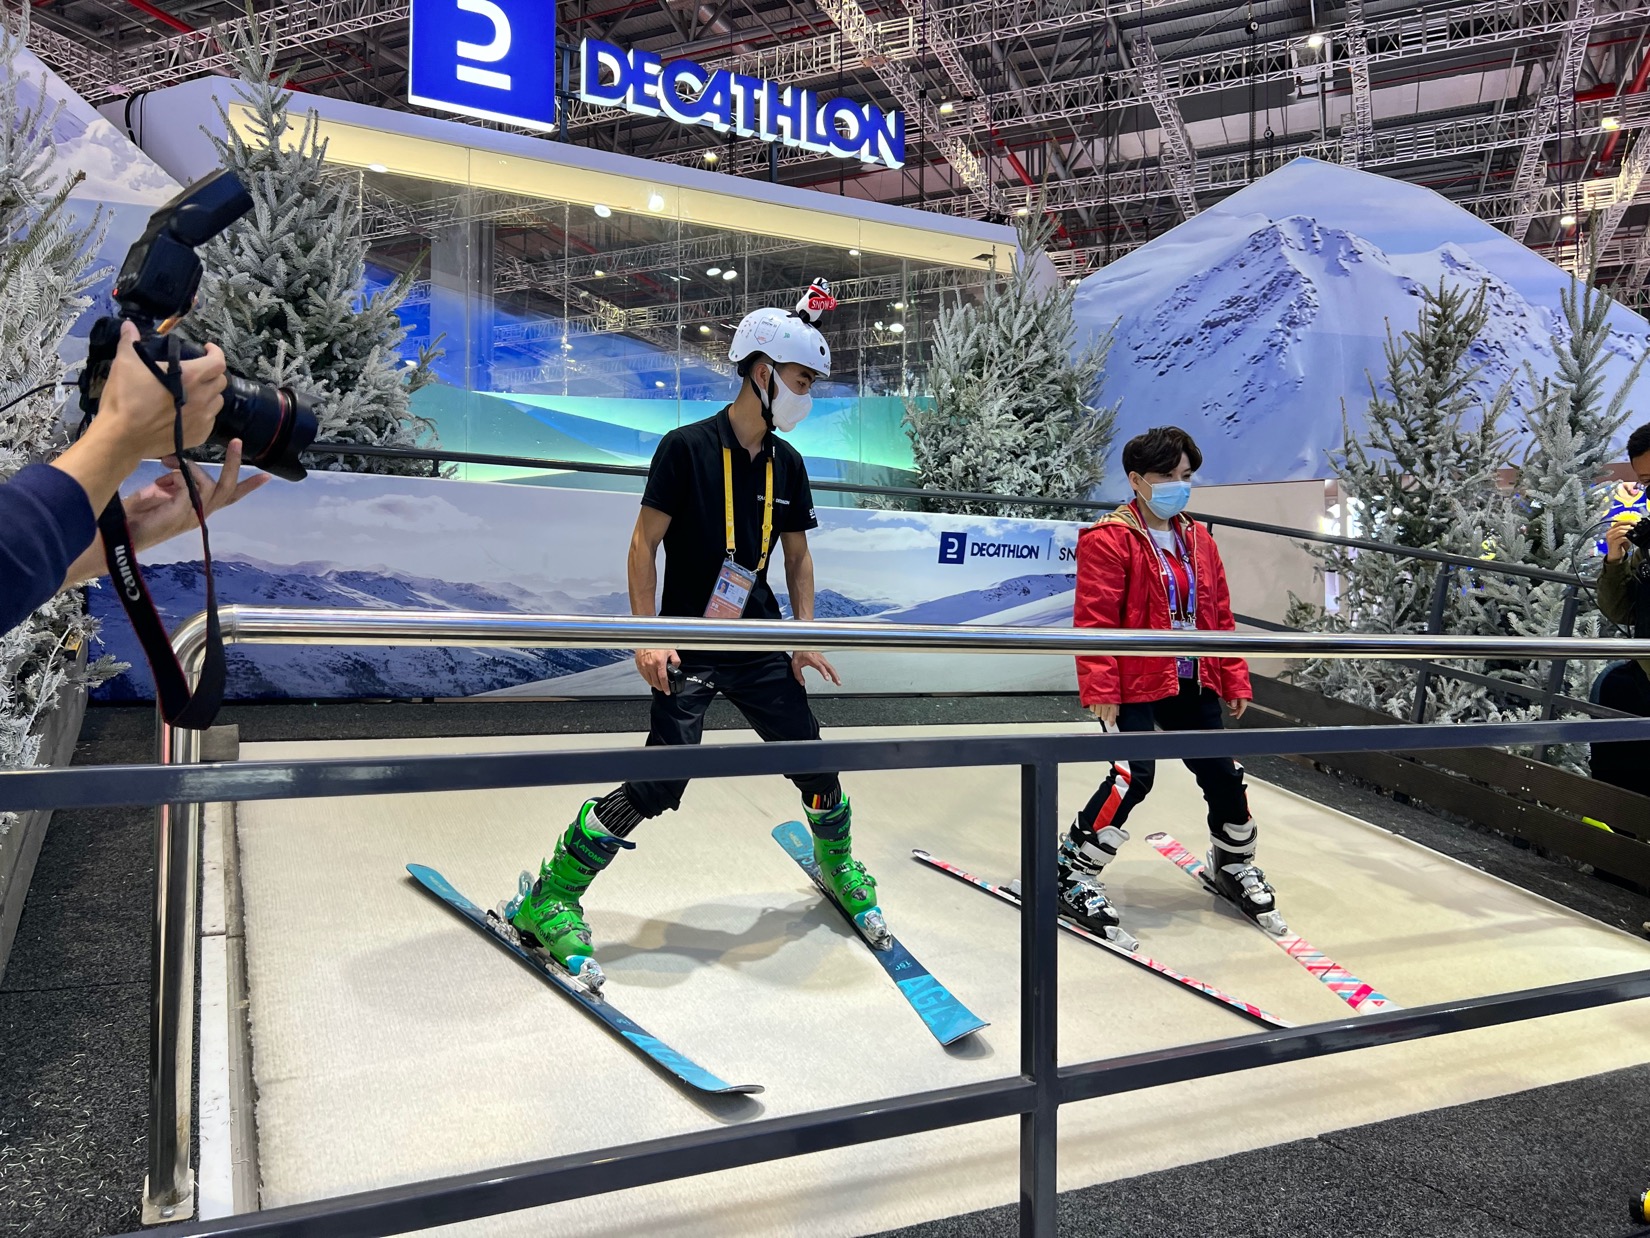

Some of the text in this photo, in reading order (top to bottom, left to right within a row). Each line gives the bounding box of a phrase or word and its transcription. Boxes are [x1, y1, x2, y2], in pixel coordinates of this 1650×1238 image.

[580, 37, 905, 169] DECATHLON
[970, 542, 1040, 560] DECATHLON
[114, 545, 141, 601] Canon
[579, 844, 607, 865] ATOMIC
